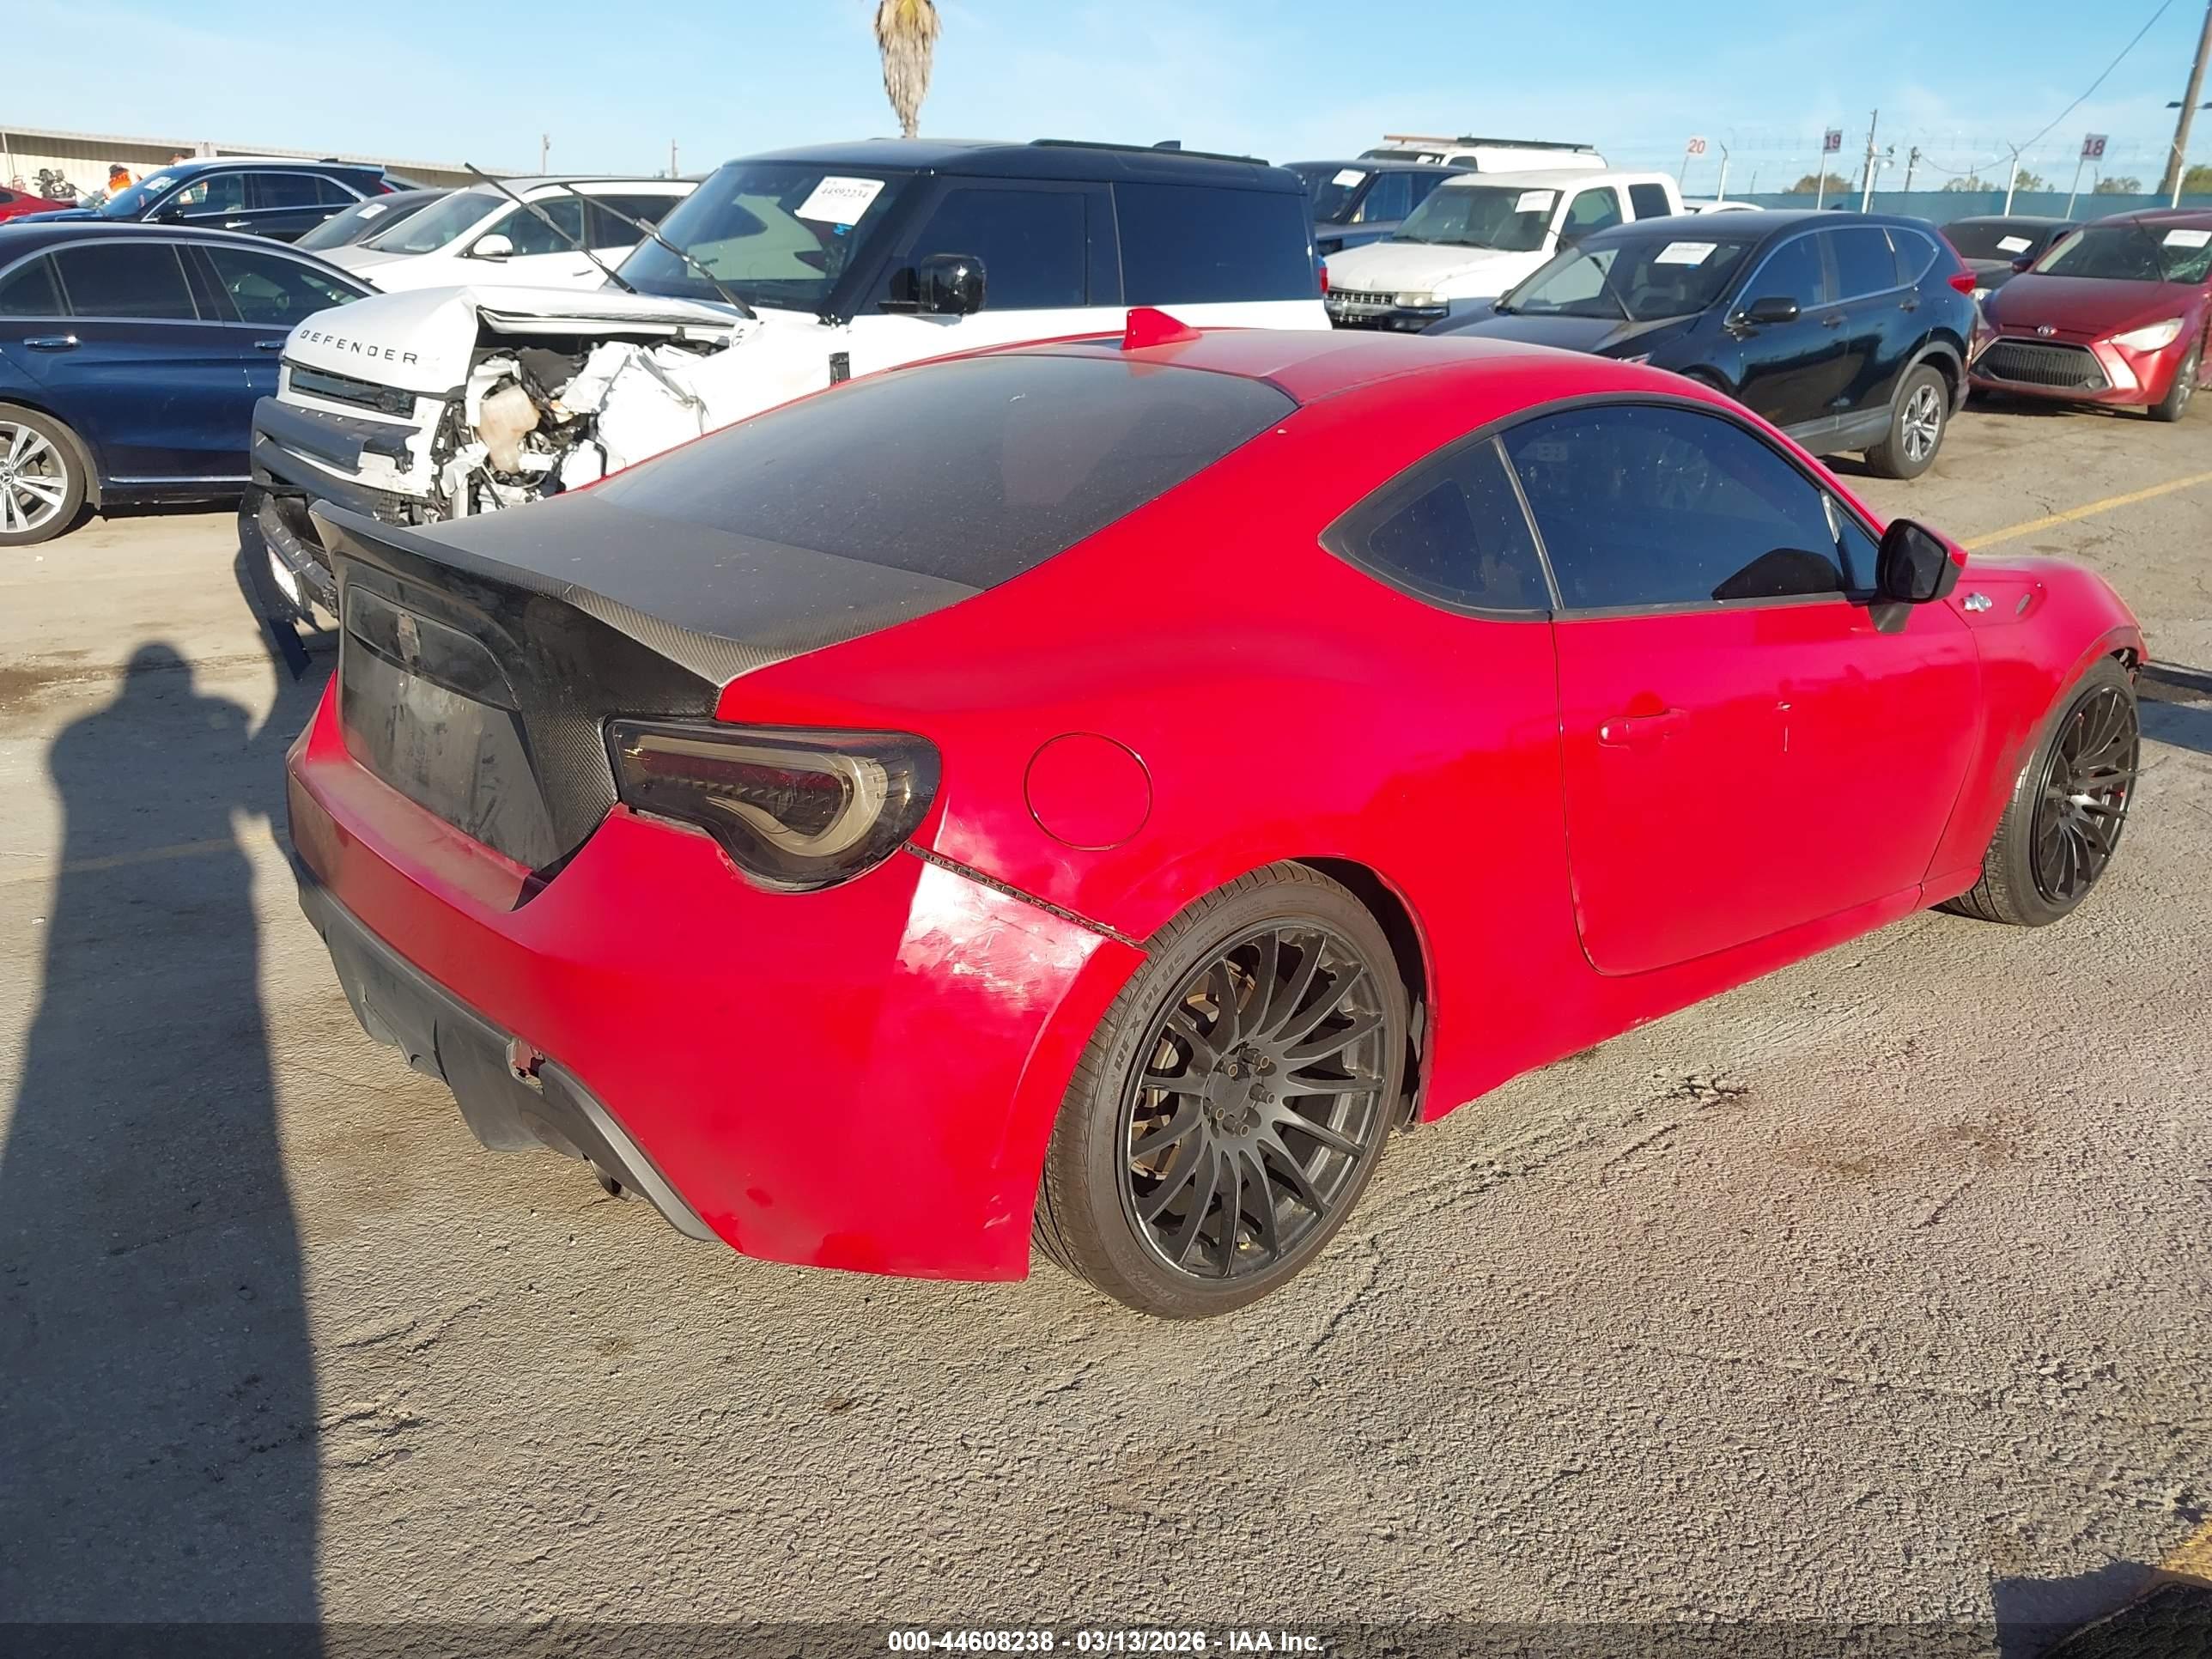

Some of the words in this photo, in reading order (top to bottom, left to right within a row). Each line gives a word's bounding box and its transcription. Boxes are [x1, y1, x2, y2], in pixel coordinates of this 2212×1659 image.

[1688, 139, 1705, 154] 20
[1824, 134, 1841, 149] 19
[2081, 139, 2105, 156] 18
[300, 329, 418, 365] DEFENDER
[1141, 951, 1187, 1012] PLUS
